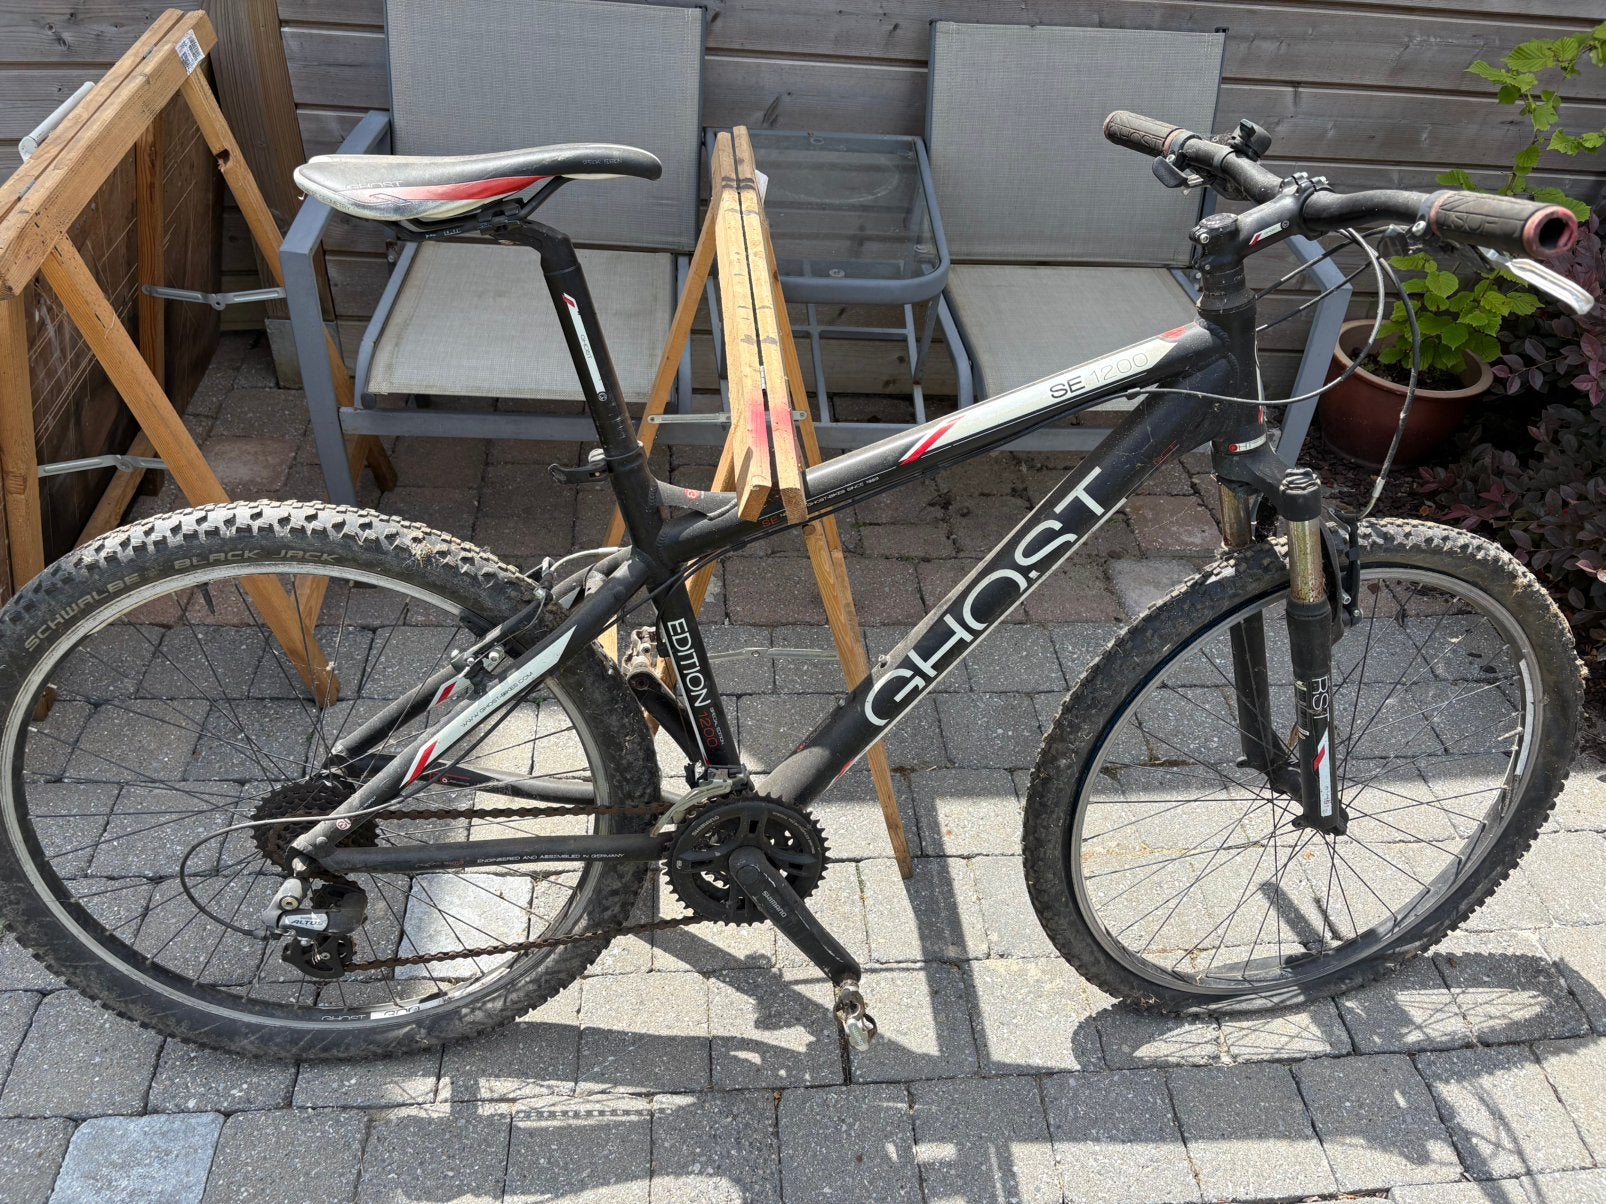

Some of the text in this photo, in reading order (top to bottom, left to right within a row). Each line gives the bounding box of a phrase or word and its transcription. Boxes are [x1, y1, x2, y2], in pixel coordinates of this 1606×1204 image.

[1049, 352, 1149, 399] SE 1200
[174, 549, 339, 570] BLACK JACK
[24, 573, 142, 652] SCHWALBE
[864, 466, 1106, 727] GHOST
[667, 617, 711, 707] EDITION
[1312, 675, 1329, 722] RST
[699, 711, 718, 748] 1200
[762, 890, 787, 918] SHIMANO
